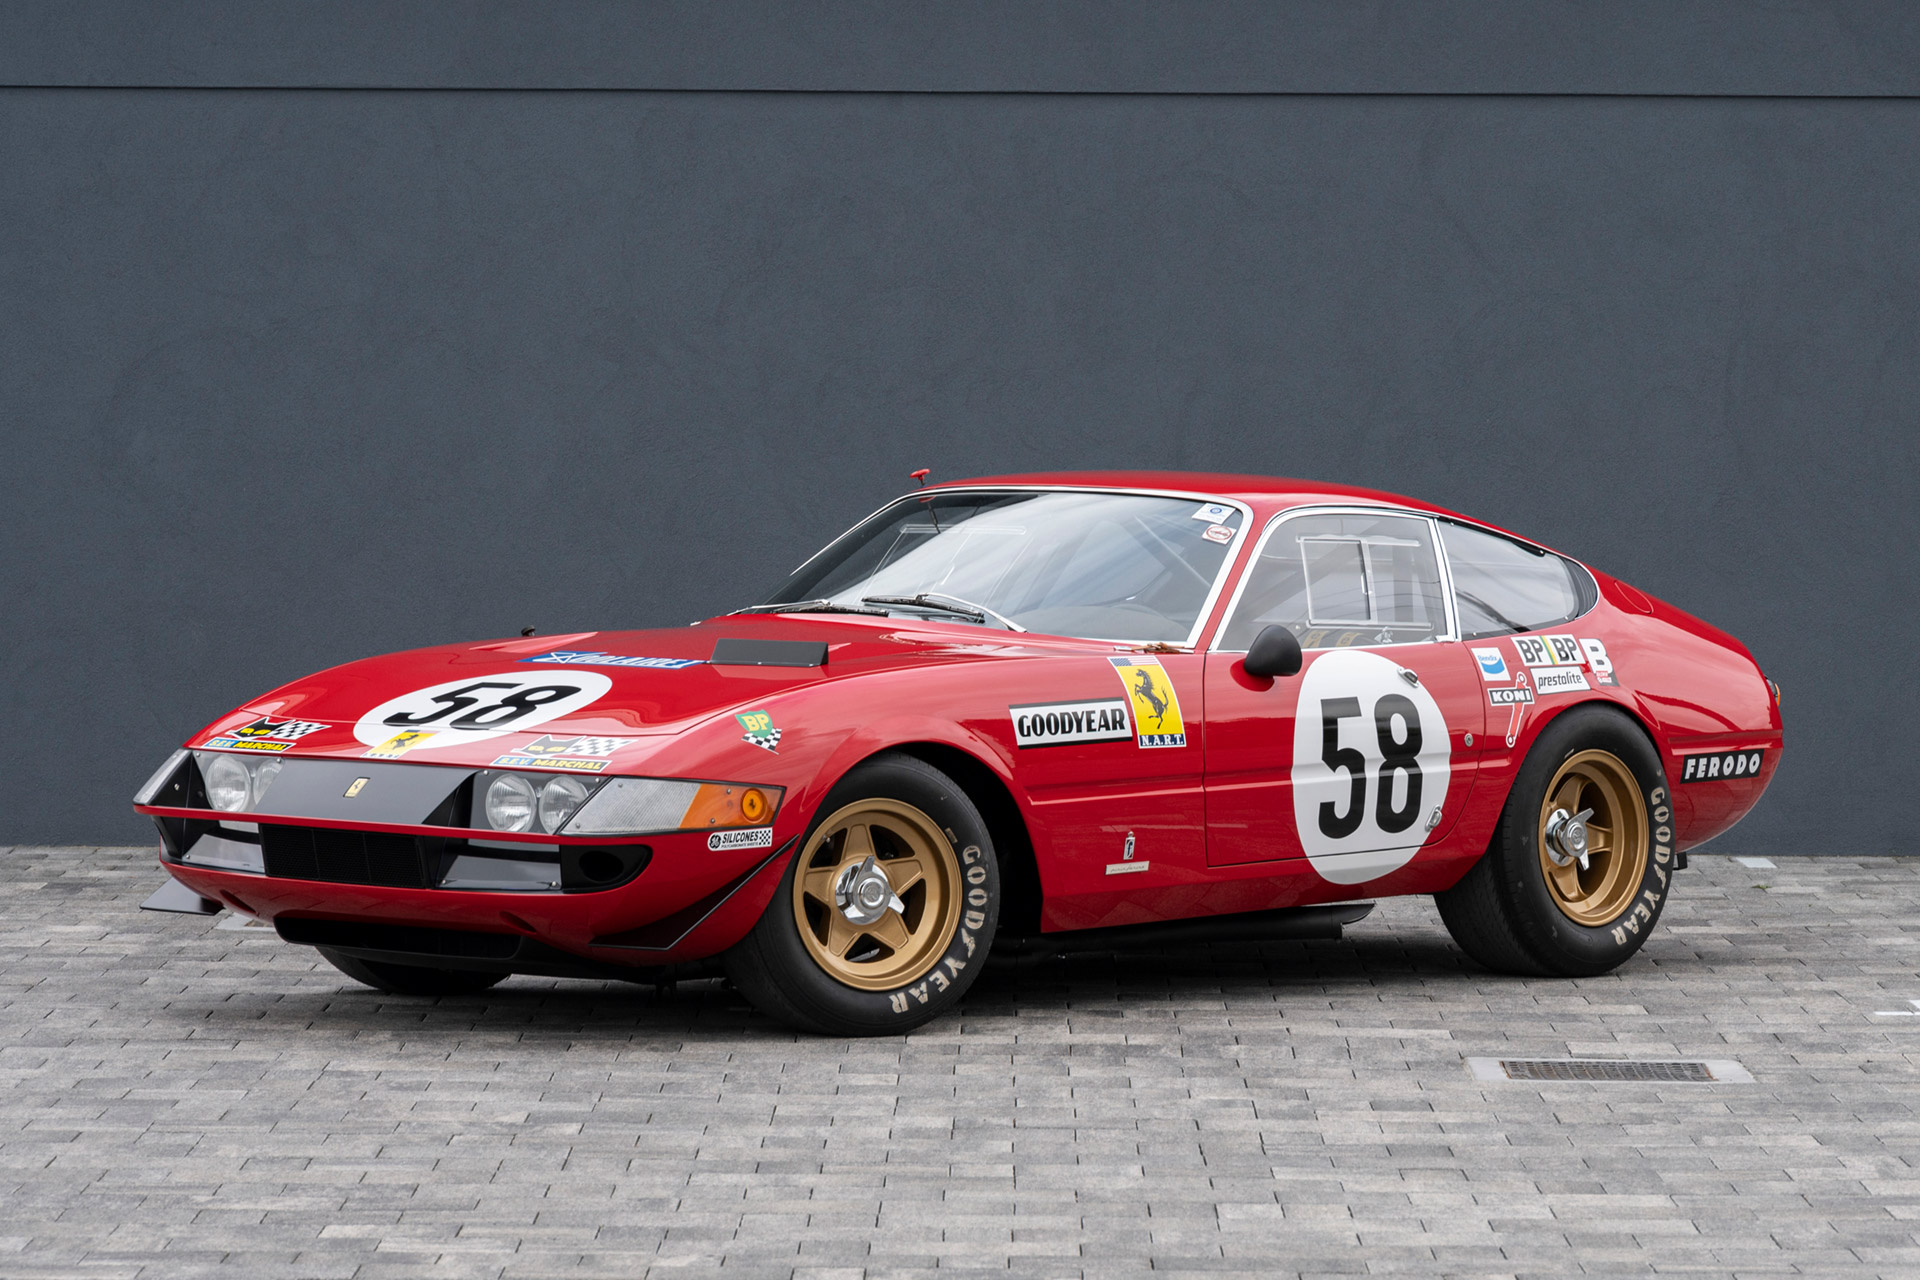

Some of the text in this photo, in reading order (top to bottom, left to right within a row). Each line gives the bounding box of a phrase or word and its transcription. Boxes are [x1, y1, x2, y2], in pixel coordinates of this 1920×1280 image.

[1516, 637, 1577, 663] BP BP
[1538, 671, 1582, 690] prestolite
[1491, 690, 1532, 702] KONI
[382, 682, 582, 730] 58
[741, 713, 769, 731] BP
[1018, 708, 1125, 738] GOODYEAR
[233, 741, 287, 751] MARCHAL
[1141, 734, 1184, 746] N.A.R.T.
[531, 758, 603, 770] MARCHAL
[1318, 694, 1423, 839] 58
[1684, 753, 1760, 780] FERODO
[722, 831, 759, 844] SILICONES
